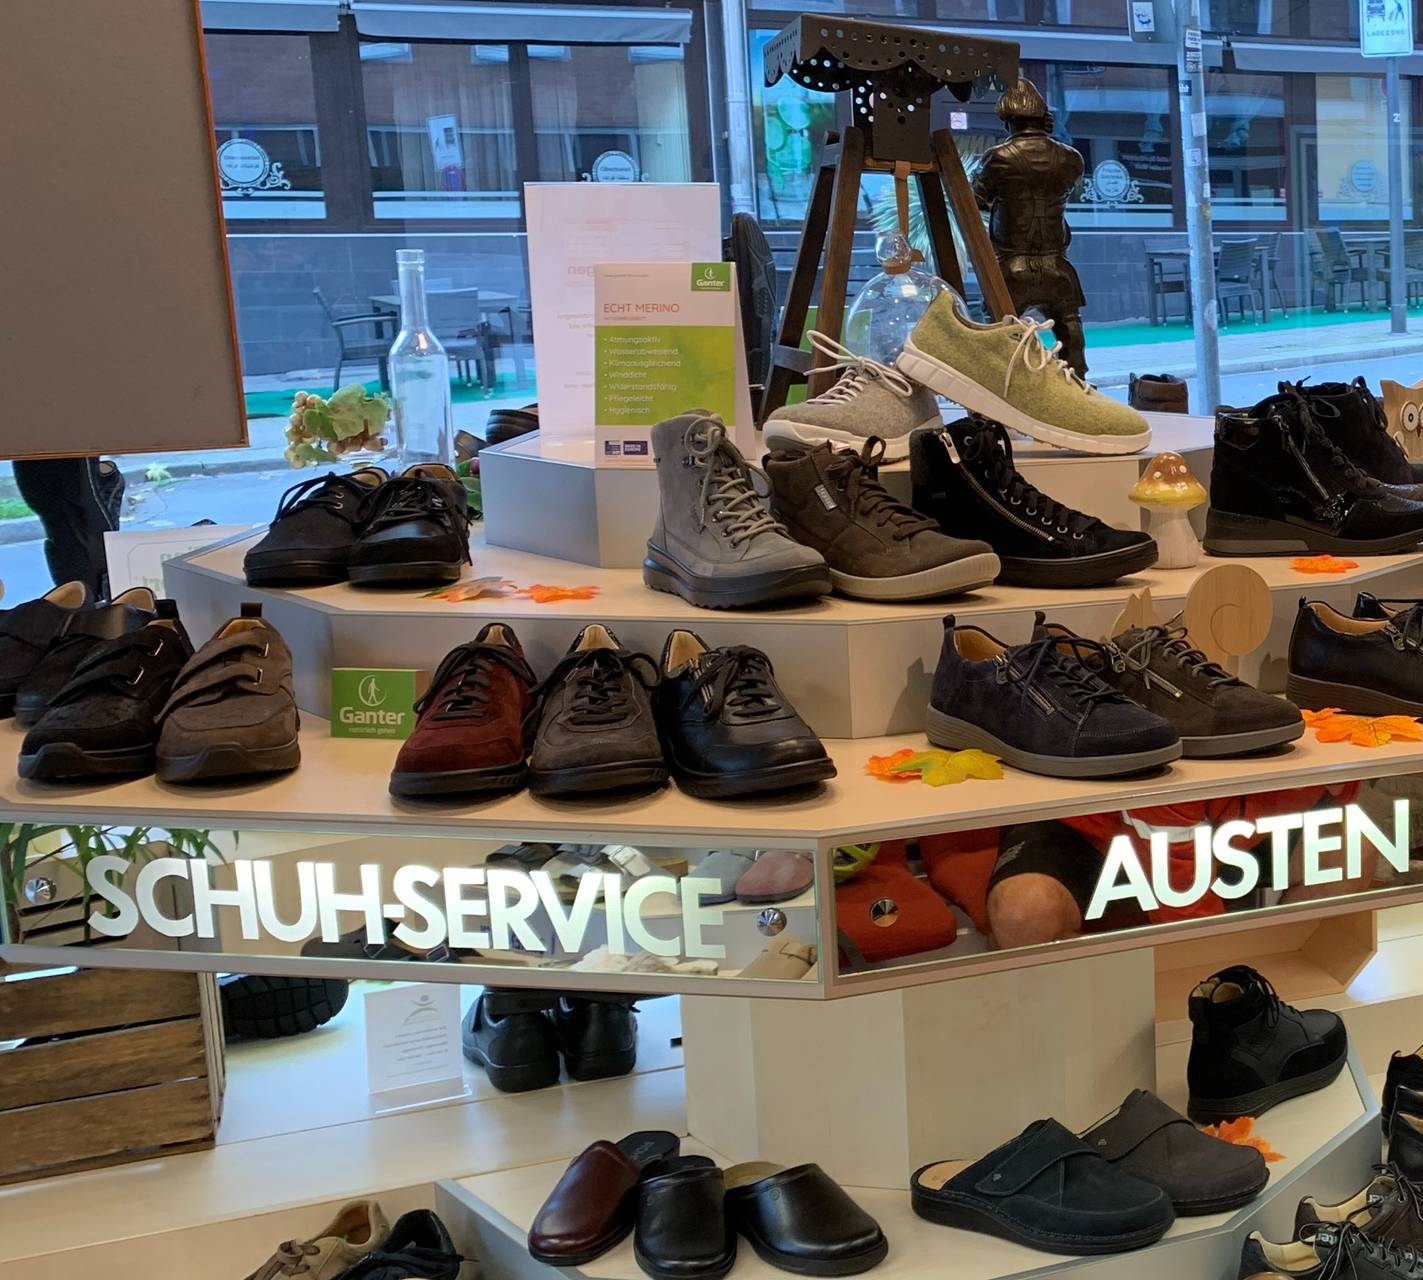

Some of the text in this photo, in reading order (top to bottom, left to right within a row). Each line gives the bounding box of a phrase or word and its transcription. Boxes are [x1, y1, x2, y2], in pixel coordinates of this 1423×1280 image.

[696, 279, 725, 287] Ganter
[603, 304, 680, 313] ECHT MERINO
[340, 706, 406, 725] Ganter
[1084, 799, 1409, 920] AUSTEN
[87, 855, 726, 959] SCHUH-SERVICE
